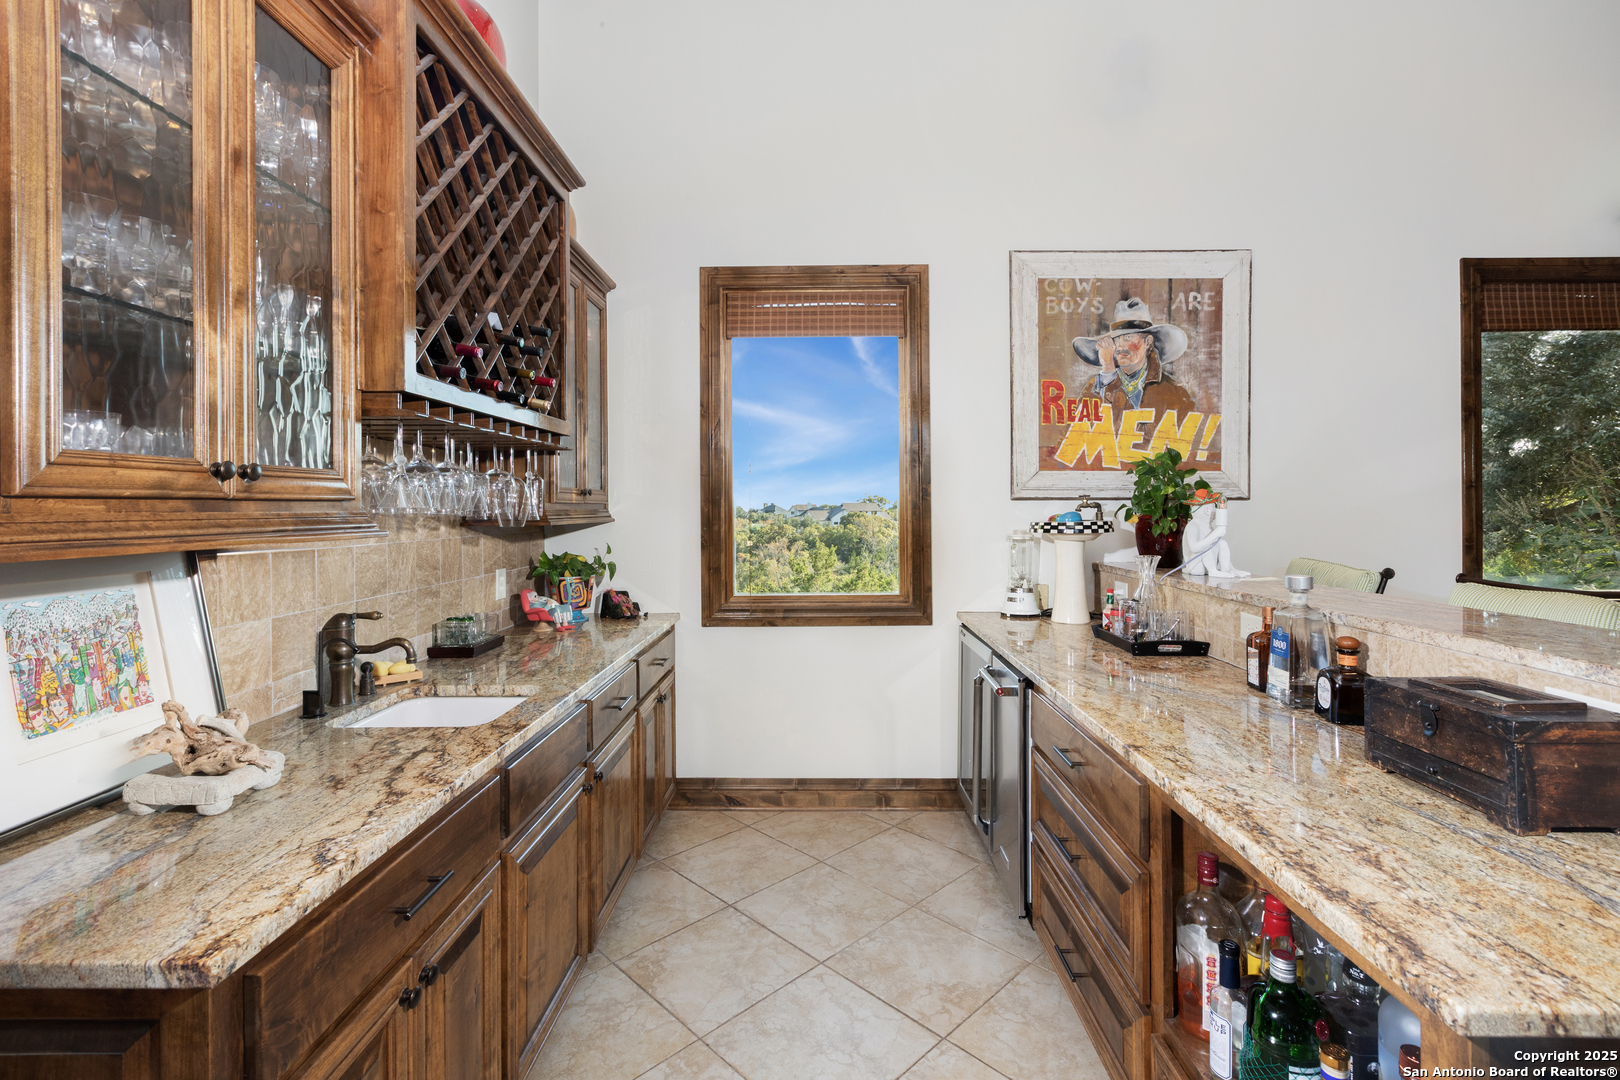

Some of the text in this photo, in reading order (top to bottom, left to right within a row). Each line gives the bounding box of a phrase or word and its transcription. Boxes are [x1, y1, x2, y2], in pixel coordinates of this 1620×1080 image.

[1046, 291, 1216, 315] BOYS ARE
[1054, 403, 1222, 469] MEN!
[1273, 639, 1286, 650] 1800
